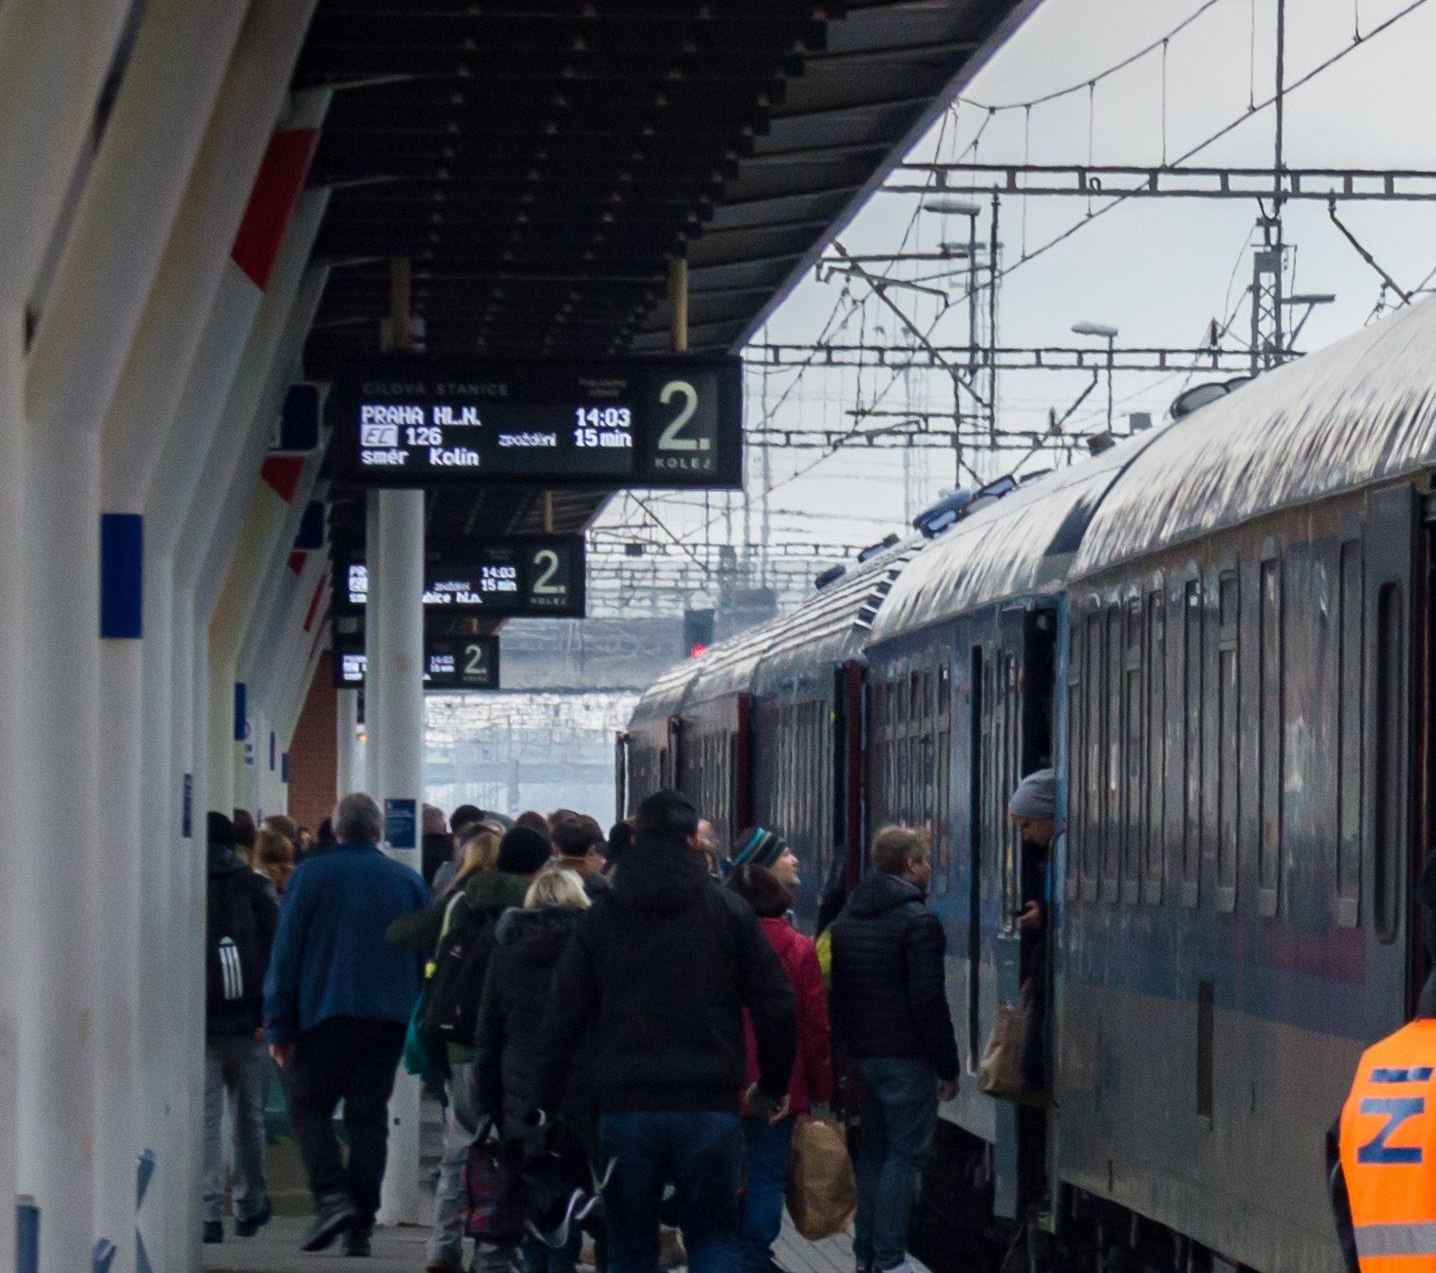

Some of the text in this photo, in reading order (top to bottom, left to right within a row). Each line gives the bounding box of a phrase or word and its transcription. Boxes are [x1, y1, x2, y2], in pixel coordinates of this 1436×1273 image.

[361, 406, 631, 427] PRAHA HL.N. 14:03
[364, 426, 396, 445] EC
[405, 427, 443, 446] 126
[574, 429, 597, 447] 15
[600, 429, 633, 447] min
[654, 457, 713, 471] KOLEJ
